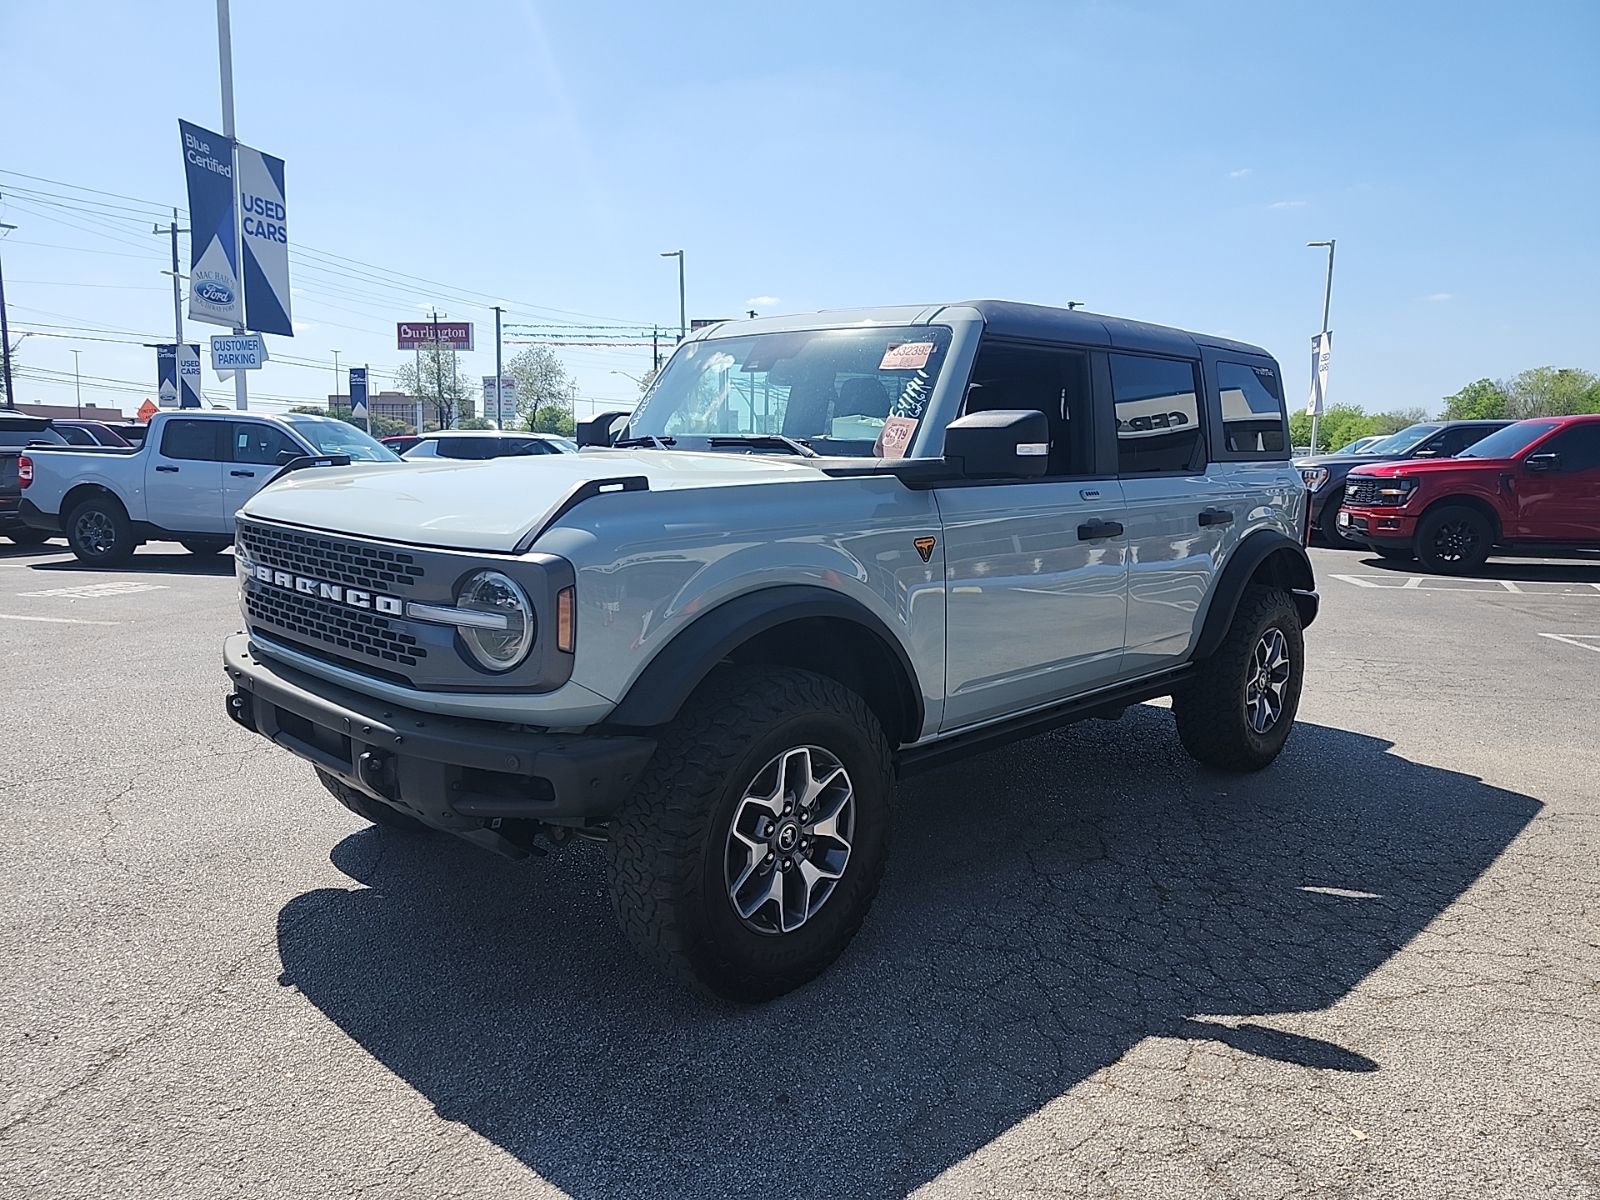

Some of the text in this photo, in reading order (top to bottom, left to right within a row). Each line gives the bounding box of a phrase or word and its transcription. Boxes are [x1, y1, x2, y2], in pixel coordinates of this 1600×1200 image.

[185, 133, 210, 154] Blue
[187, 150, 232, 178] Certified
[242, 192, 286, 221] USED
[243, 216, 287, 244] CARS
[202, 282, 230, 302] Ford
[213, 340, 259, 351] CUSTOMER
[218, 353, 256, 365] PARKING
[256, 565, 402, 616] BRONCO
